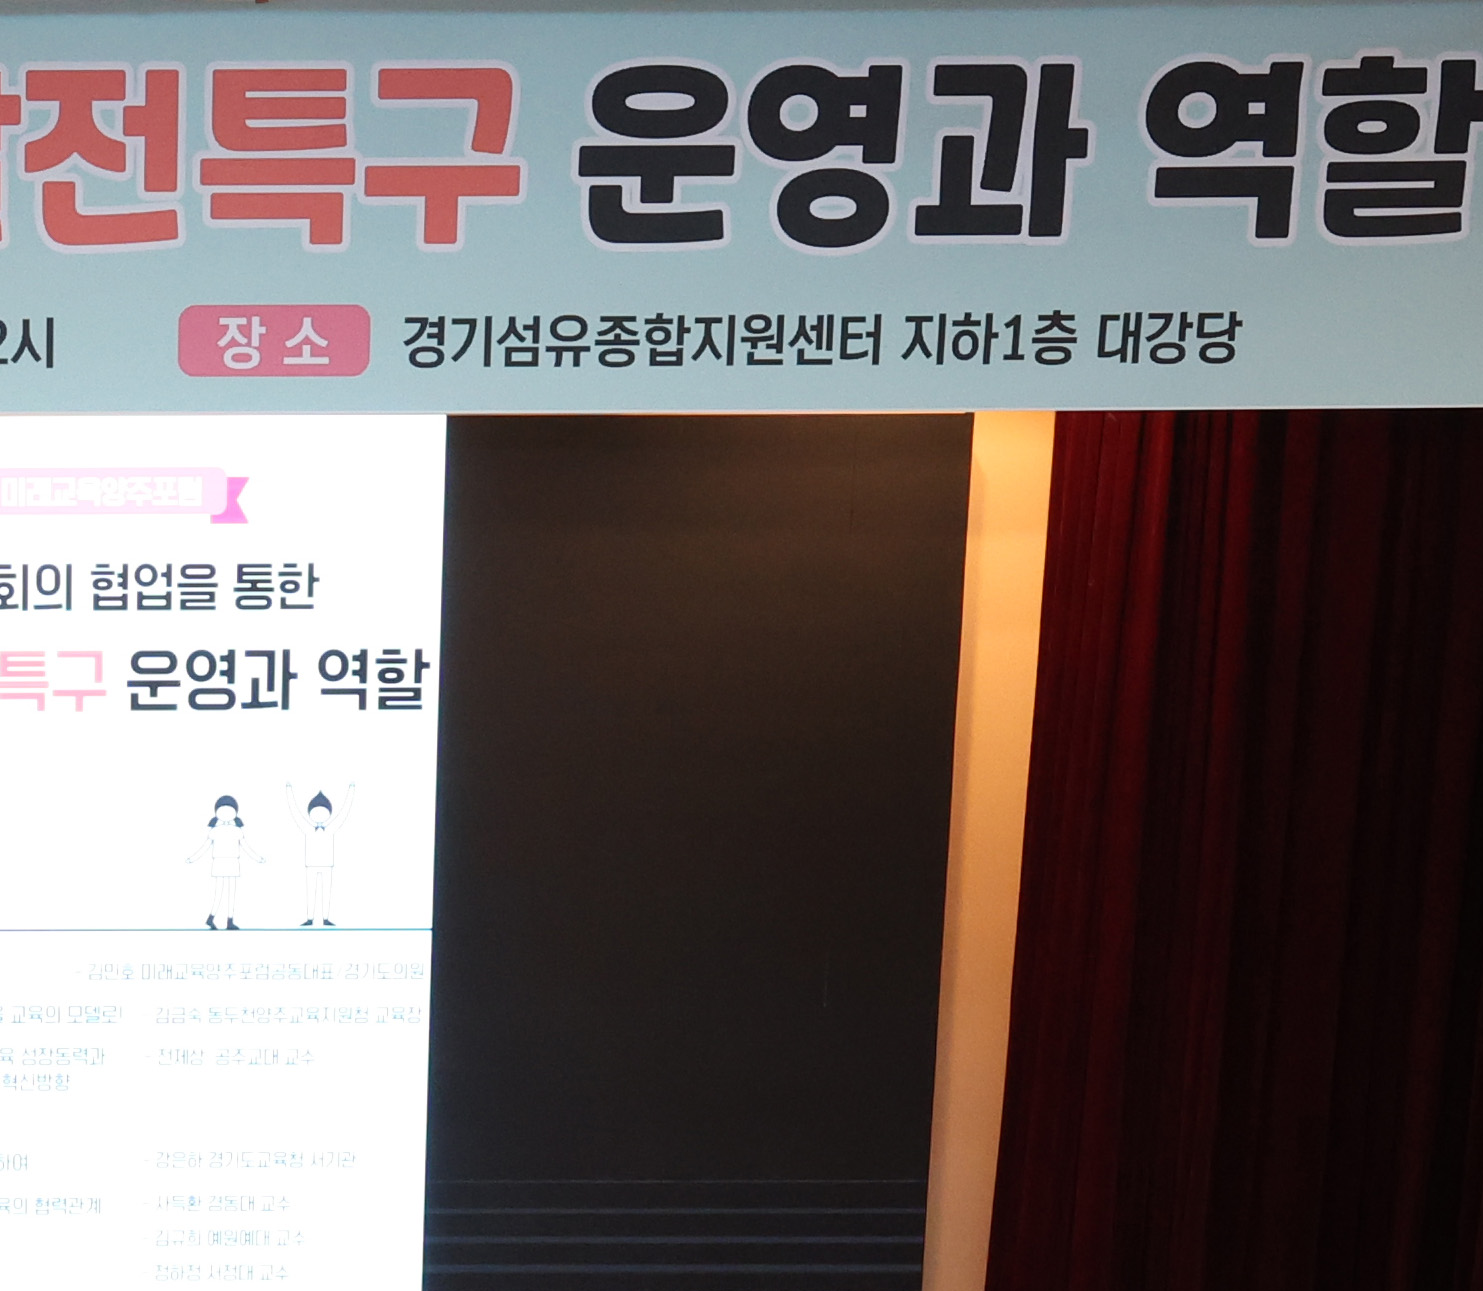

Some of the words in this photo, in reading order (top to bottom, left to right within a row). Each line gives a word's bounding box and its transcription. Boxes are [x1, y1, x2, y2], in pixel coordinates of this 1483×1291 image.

[577, 61, 1087, 248] 운영과
[402, 311, 884, 370] 경기섬유종합지원센터
[901, 311, 1079, 368] 지하1층
[1095, 307, 1243, 368] 대강당
[91, 563, 219, 612] 협업을
[233, 562, 320, 611] 통한
[127, 648, 298, 712] 운영과
[318, 648, 430, 710] 역할
